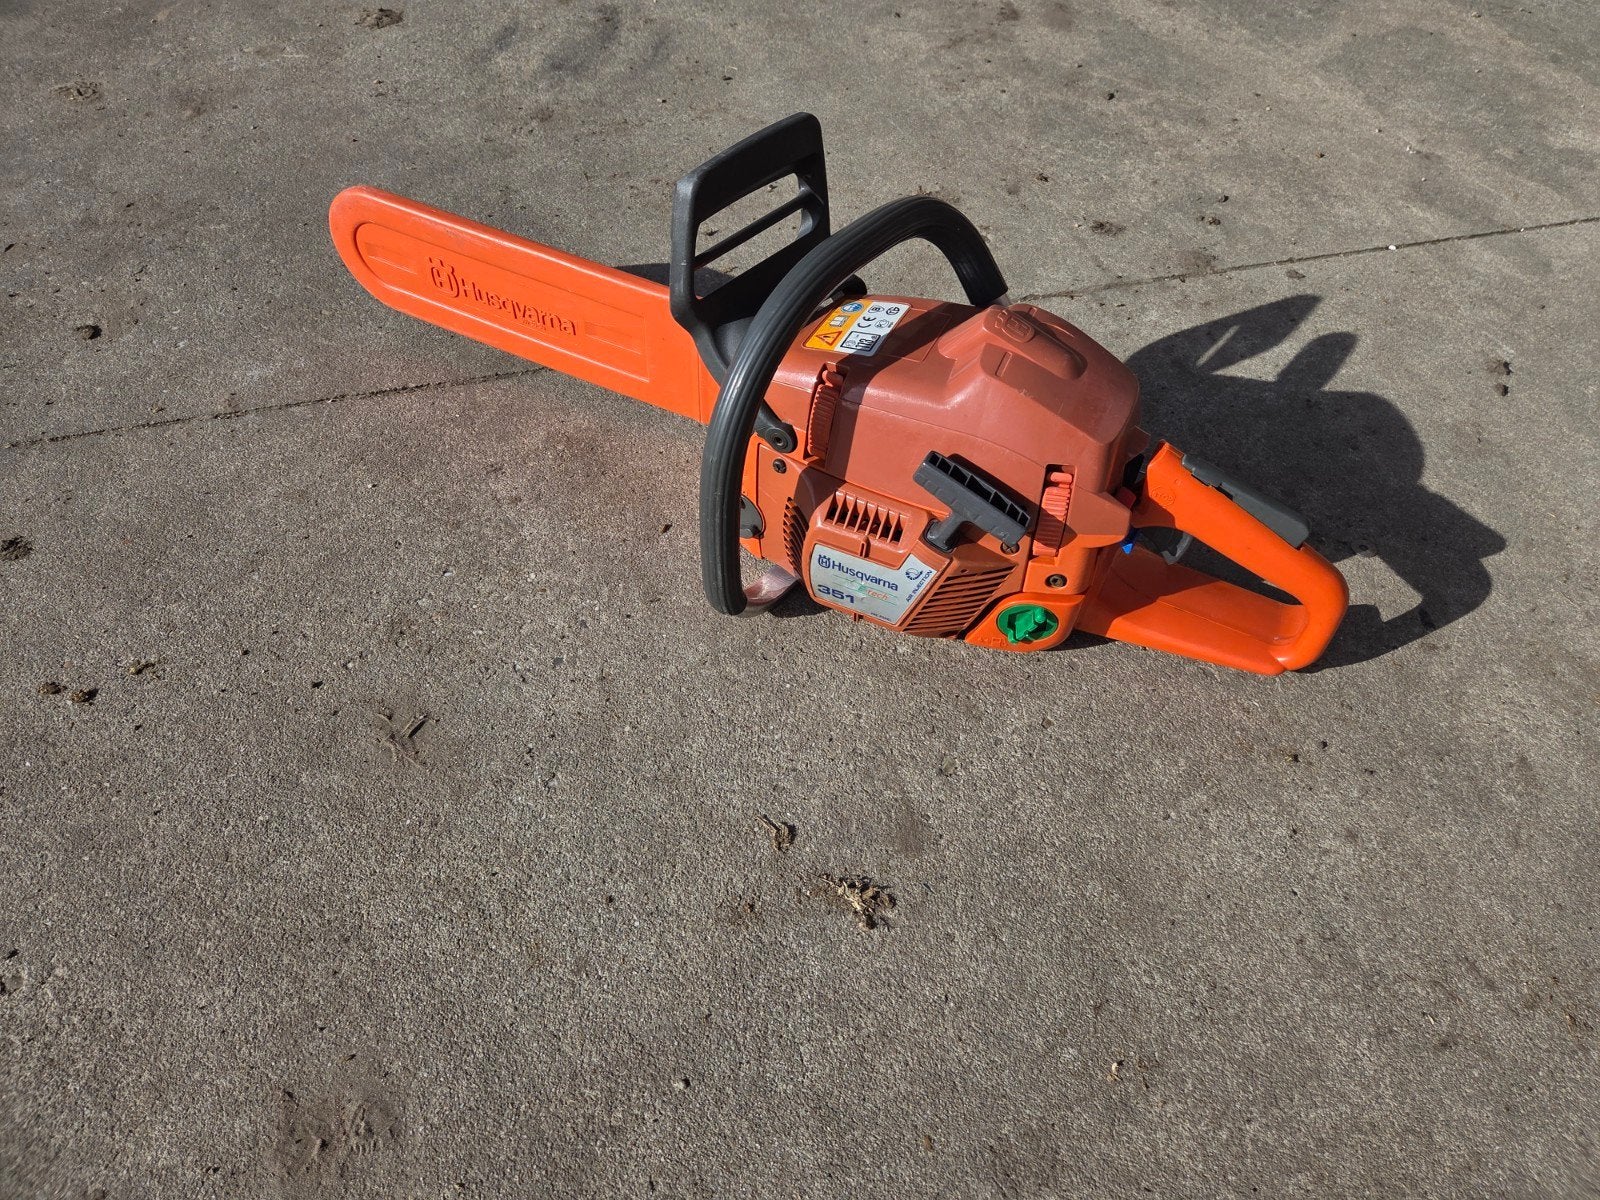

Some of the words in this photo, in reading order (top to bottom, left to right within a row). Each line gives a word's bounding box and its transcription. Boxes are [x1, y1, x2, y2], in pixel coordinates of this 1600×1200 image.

[460, 278, 577, 336] Husqvarna
[831, 560, 898, 592] Husqvarna
[911, 570, 933, 595] INJECTION
[817, 584, 855, 604] 351
